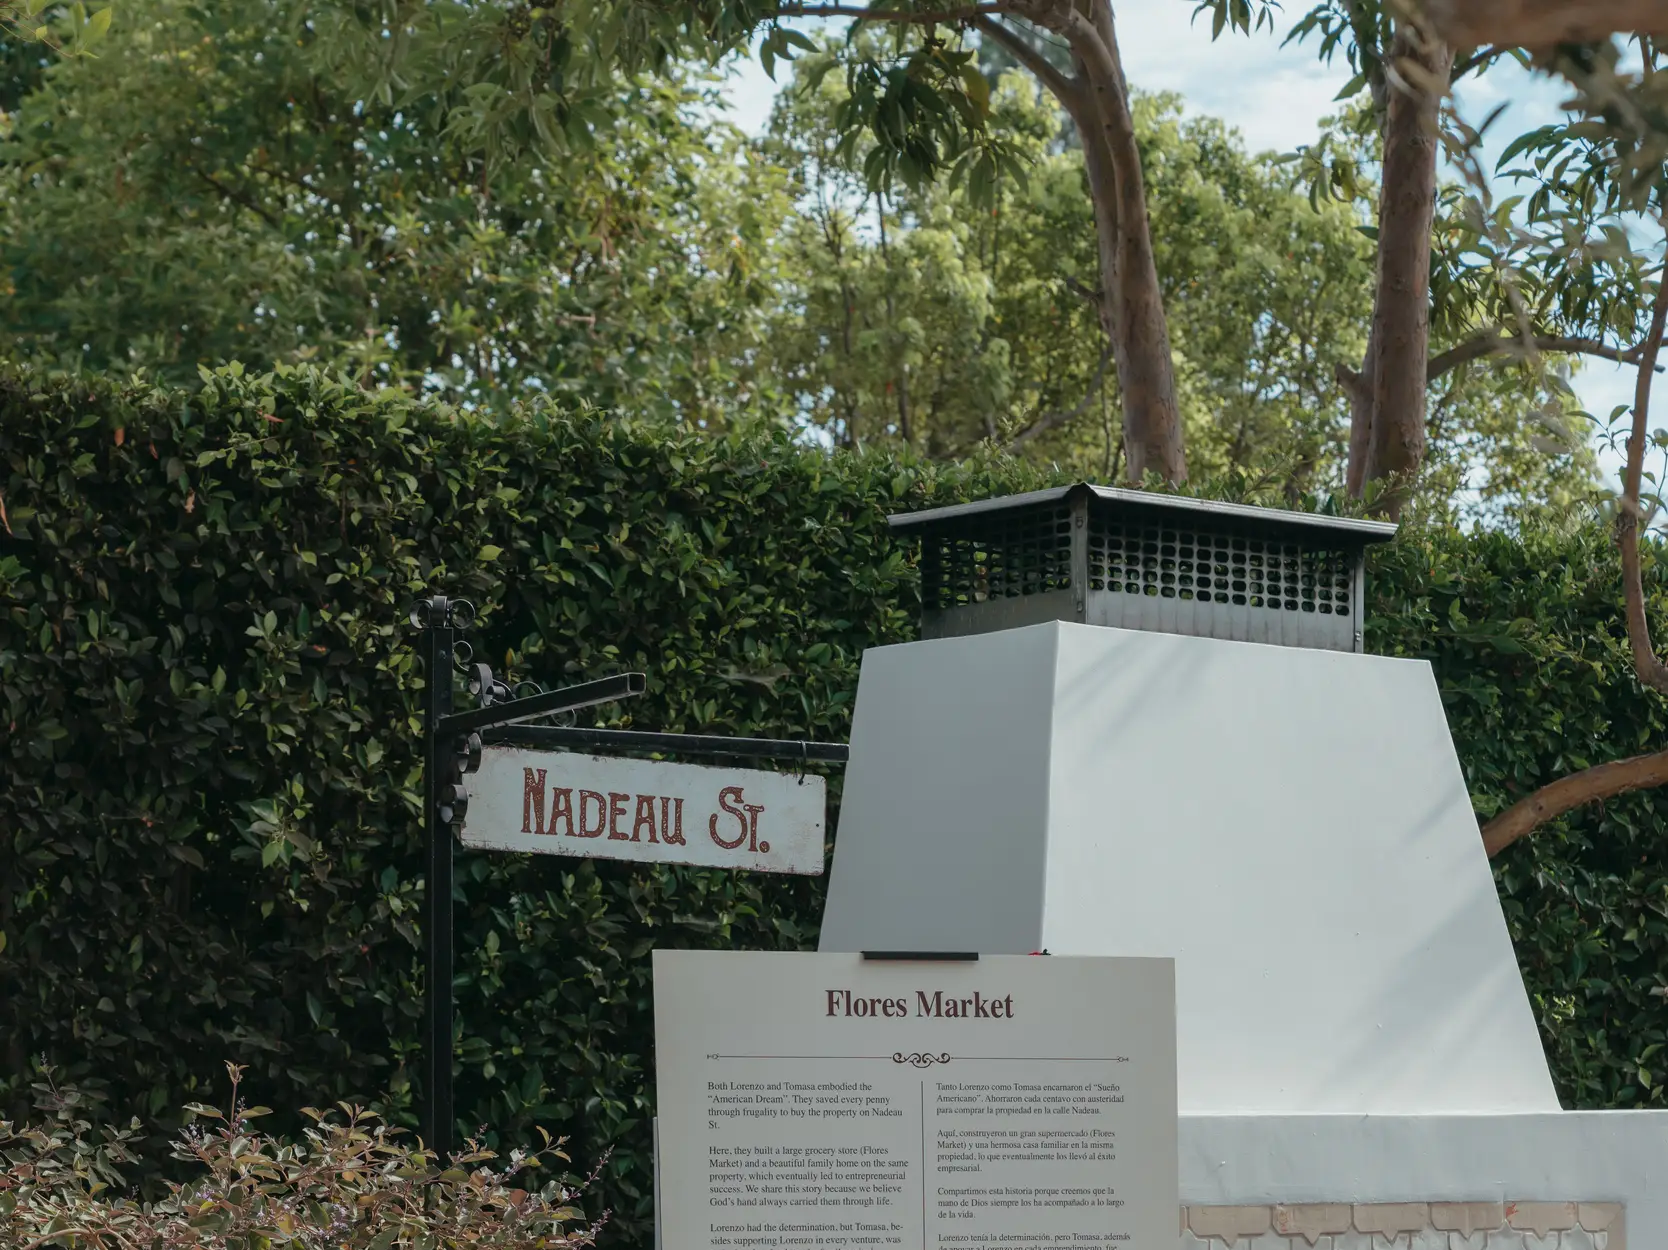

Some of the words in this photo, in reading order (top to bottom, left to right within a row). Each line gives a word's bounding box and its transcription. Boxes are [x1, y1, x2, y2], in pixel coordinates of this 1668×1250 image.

[825, 989, 907, 1017] Flores
[915, 990, 1014, 1018] Market
[707, 1081, 728, 1090] Both
[729, 1082, 765, 1090] Lorenzo
[766, 1082, 782, 1090] and
[782, 1082, 816, 1090] Tomasa
[816, 1082, 857, 1090] embodied
[859, 1082, 872, 1090] the
[935, 1082, 957, 1091] Tanto
[958, 1082, 990, 1091] Lorenzo
[1012, 1082, 1042, 1091] Tomasa
[1084, 1082, 1092, 1091] el
[791, 1095, 813, 1106] They
[815, 1095, 839, 1104] saved
[840, 1097, 863, 1106] every
[865, 1097, 890, 1106] penny
[985, 1094, 1022, 1102] Ahorraron
[1023, 1094, 1040, 1102] cada
[1042, 1094, 1071, 1102] centavo
[1087, 1094, 1124, 1102] austeridad
[708, 1107, 740, 1118] through
[742, 1107, 777, 1118] frugality
[780, 1107, 788, 1116] to
[790, 1108, 805, 1118] buy
[808, 1108, 820, 1116] the
[823, 1108, 857, 1119] property
[872, 1108, 902, 1116] Nadeau
[936, 1108, 953, 1116] para
[953, 1108, 985, 1116] comprar
[986, 1105, 994, 1114] la
[994, 1105, 1032, 1116] propiedad
[1043, 1105, 1051, 1114] la
[1052, 1105, 1070, 1114] calle
[708, 1120, 720, 1129] St.
[709, 1146, 732, 1157] Here,
[733, 1146, 751, 1157] they
[754, 1146, 773, 1154] built
[782, 1146, 802, 1157] large
[804, 1148, 835, 1157] grocery
[837, 1146, 857, 1154] store
[859, 1146, 888, 1157] (Flores
[709, 1159, 742, 1170] Market)
[744, 1159, 759, 1167] and
[768, 1159, 804, 1167] beautiful
[807, 1159, 833, 1170] family
[835, 1158, 858, 1167] home
[873, 1158, 885, 1167] the
[709, 1172, 746, 1183] property,
[748, 1172, 773, 1180] which
[775, 1171, 817, 1183] eventually
[820, 1171, 832, 1180] led
[834, 1171, 843, 1180] to
[845, 1171, 905, 1182] entrepreneurial
